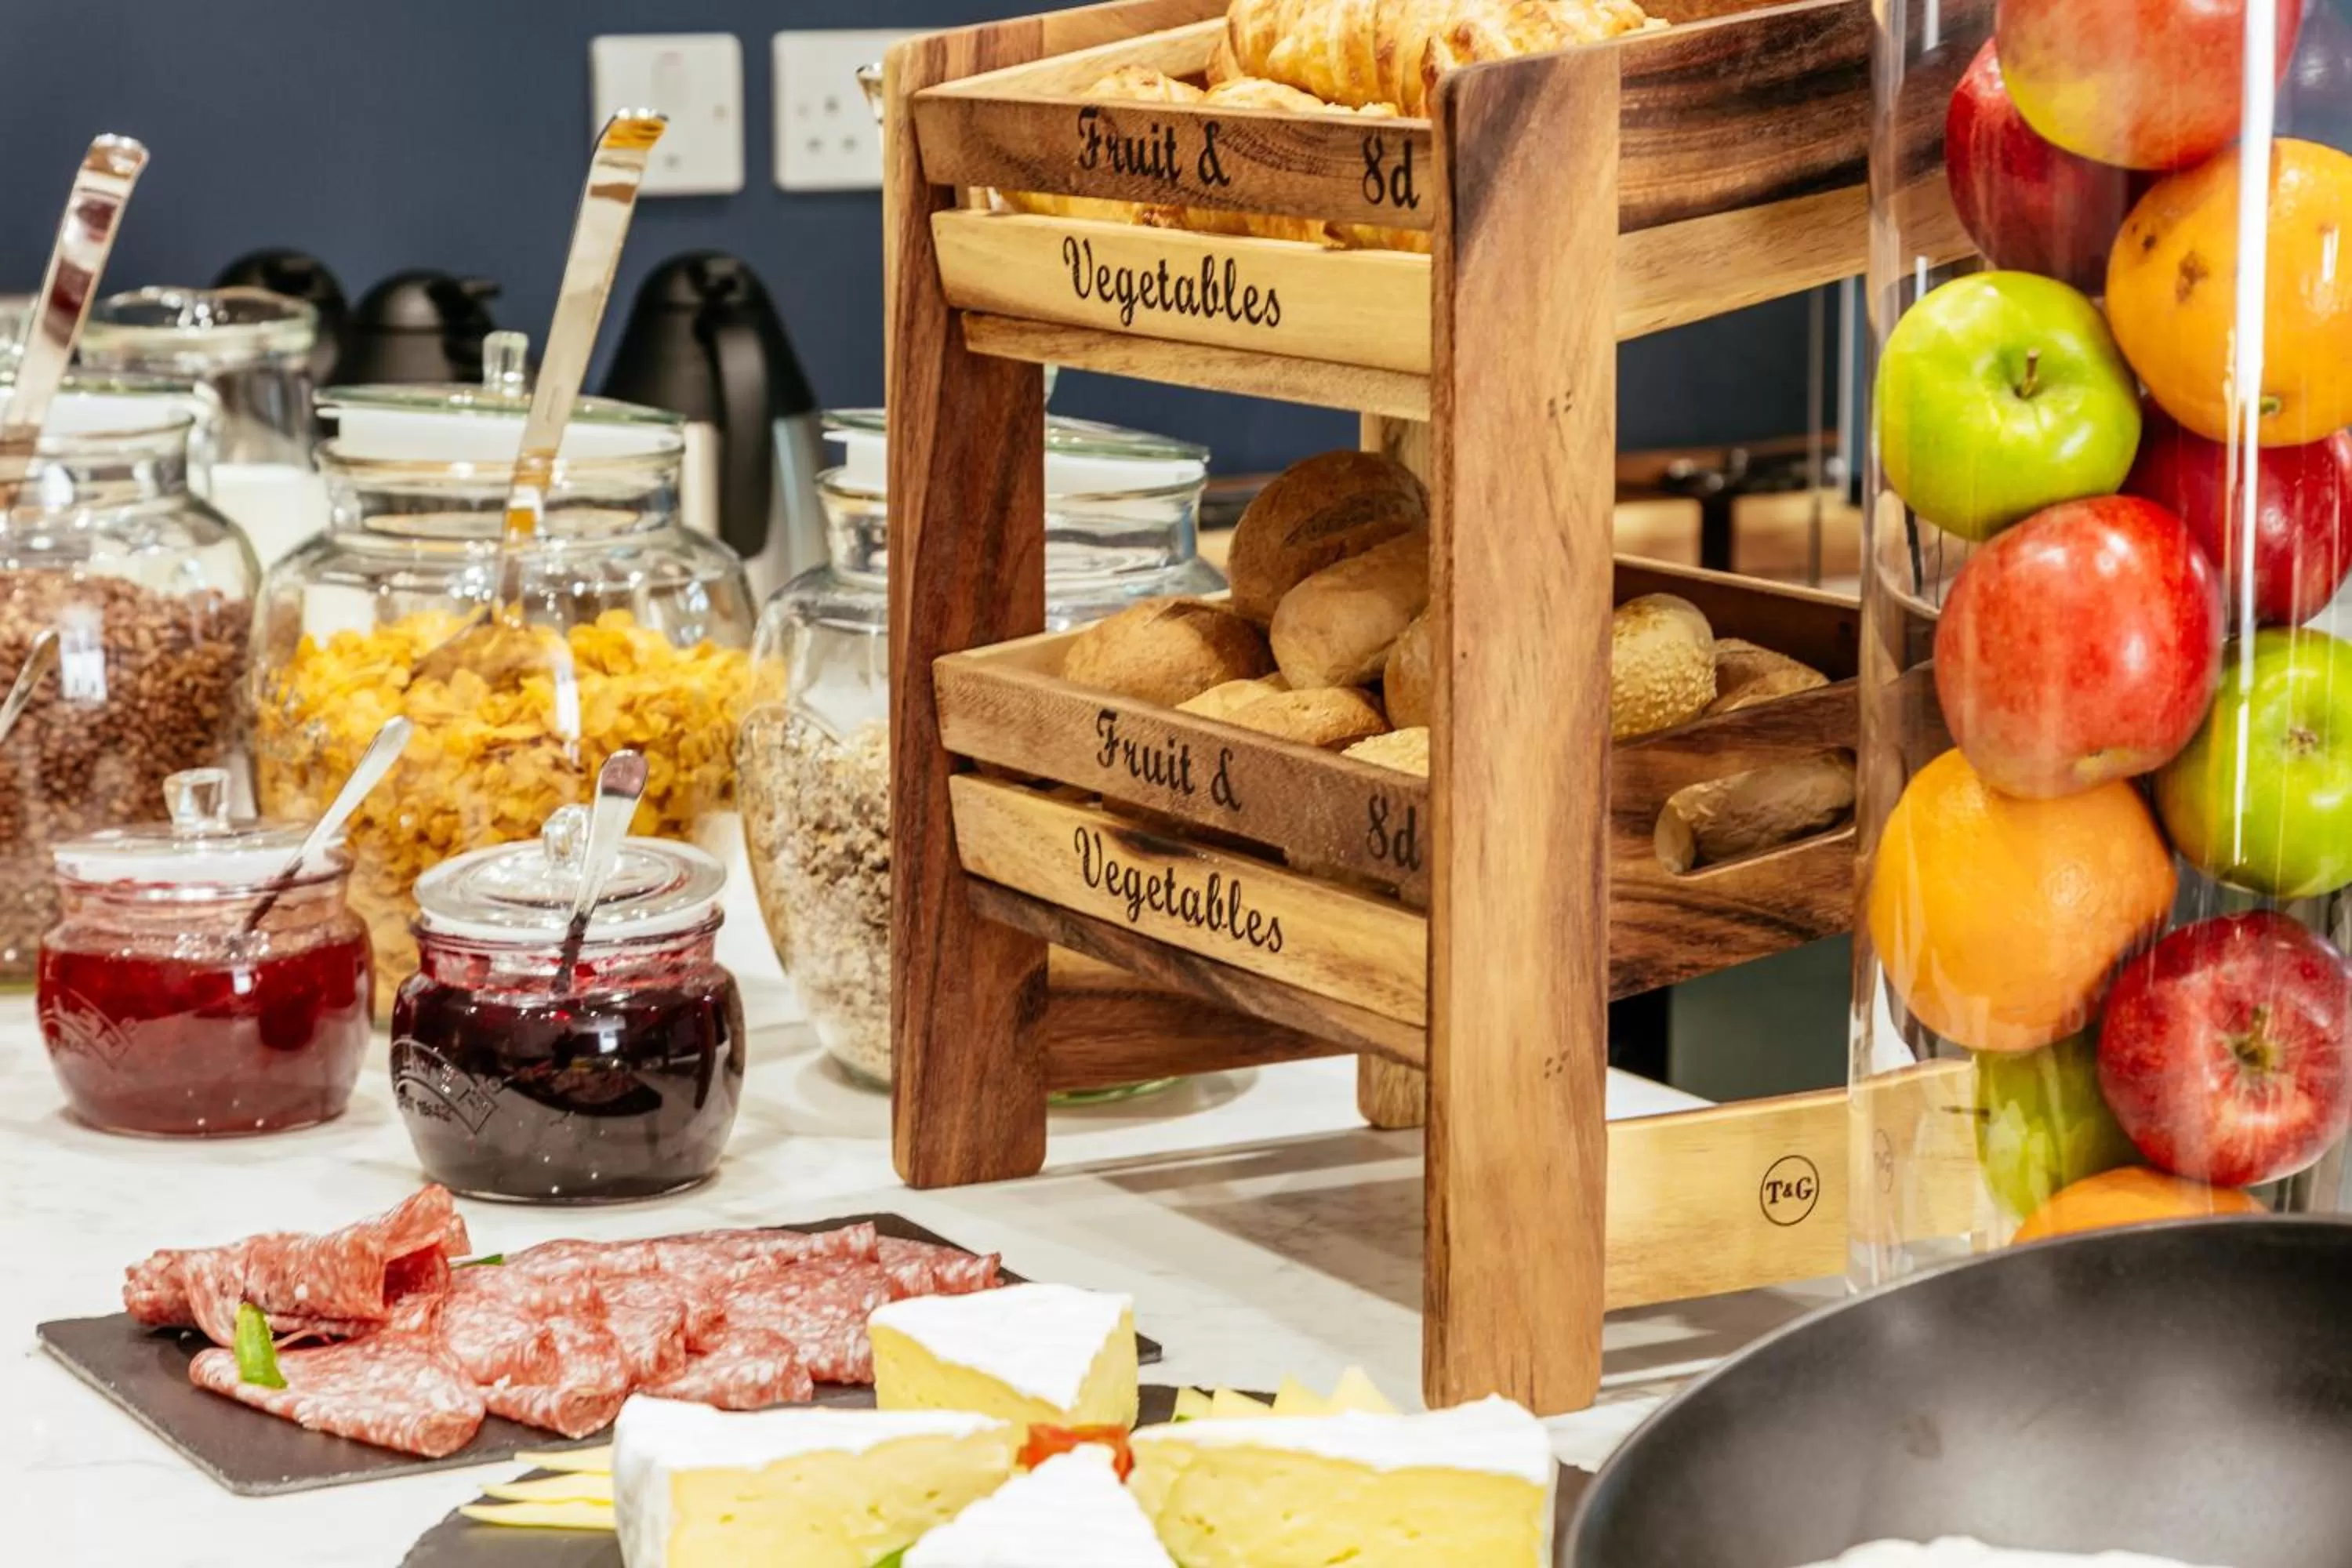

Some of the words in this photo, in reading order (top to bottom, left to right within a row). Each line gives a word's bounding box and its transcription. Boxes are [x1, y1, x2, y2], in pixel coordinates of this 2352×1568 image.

[1078, 105, 1181, 186] Fruit
[1198, 120, 1231, 187] &
[1361, 136, 1421, 209] 8d
[1062, 235, 1281, 327] Vegetables
[1097, 709, 1196, 795] Fruit
[1210, 747, 1242, 811] &
[1074, 826, 1283, 953] Vegetables
[1766, 1176, 1814, 1205] T&G
